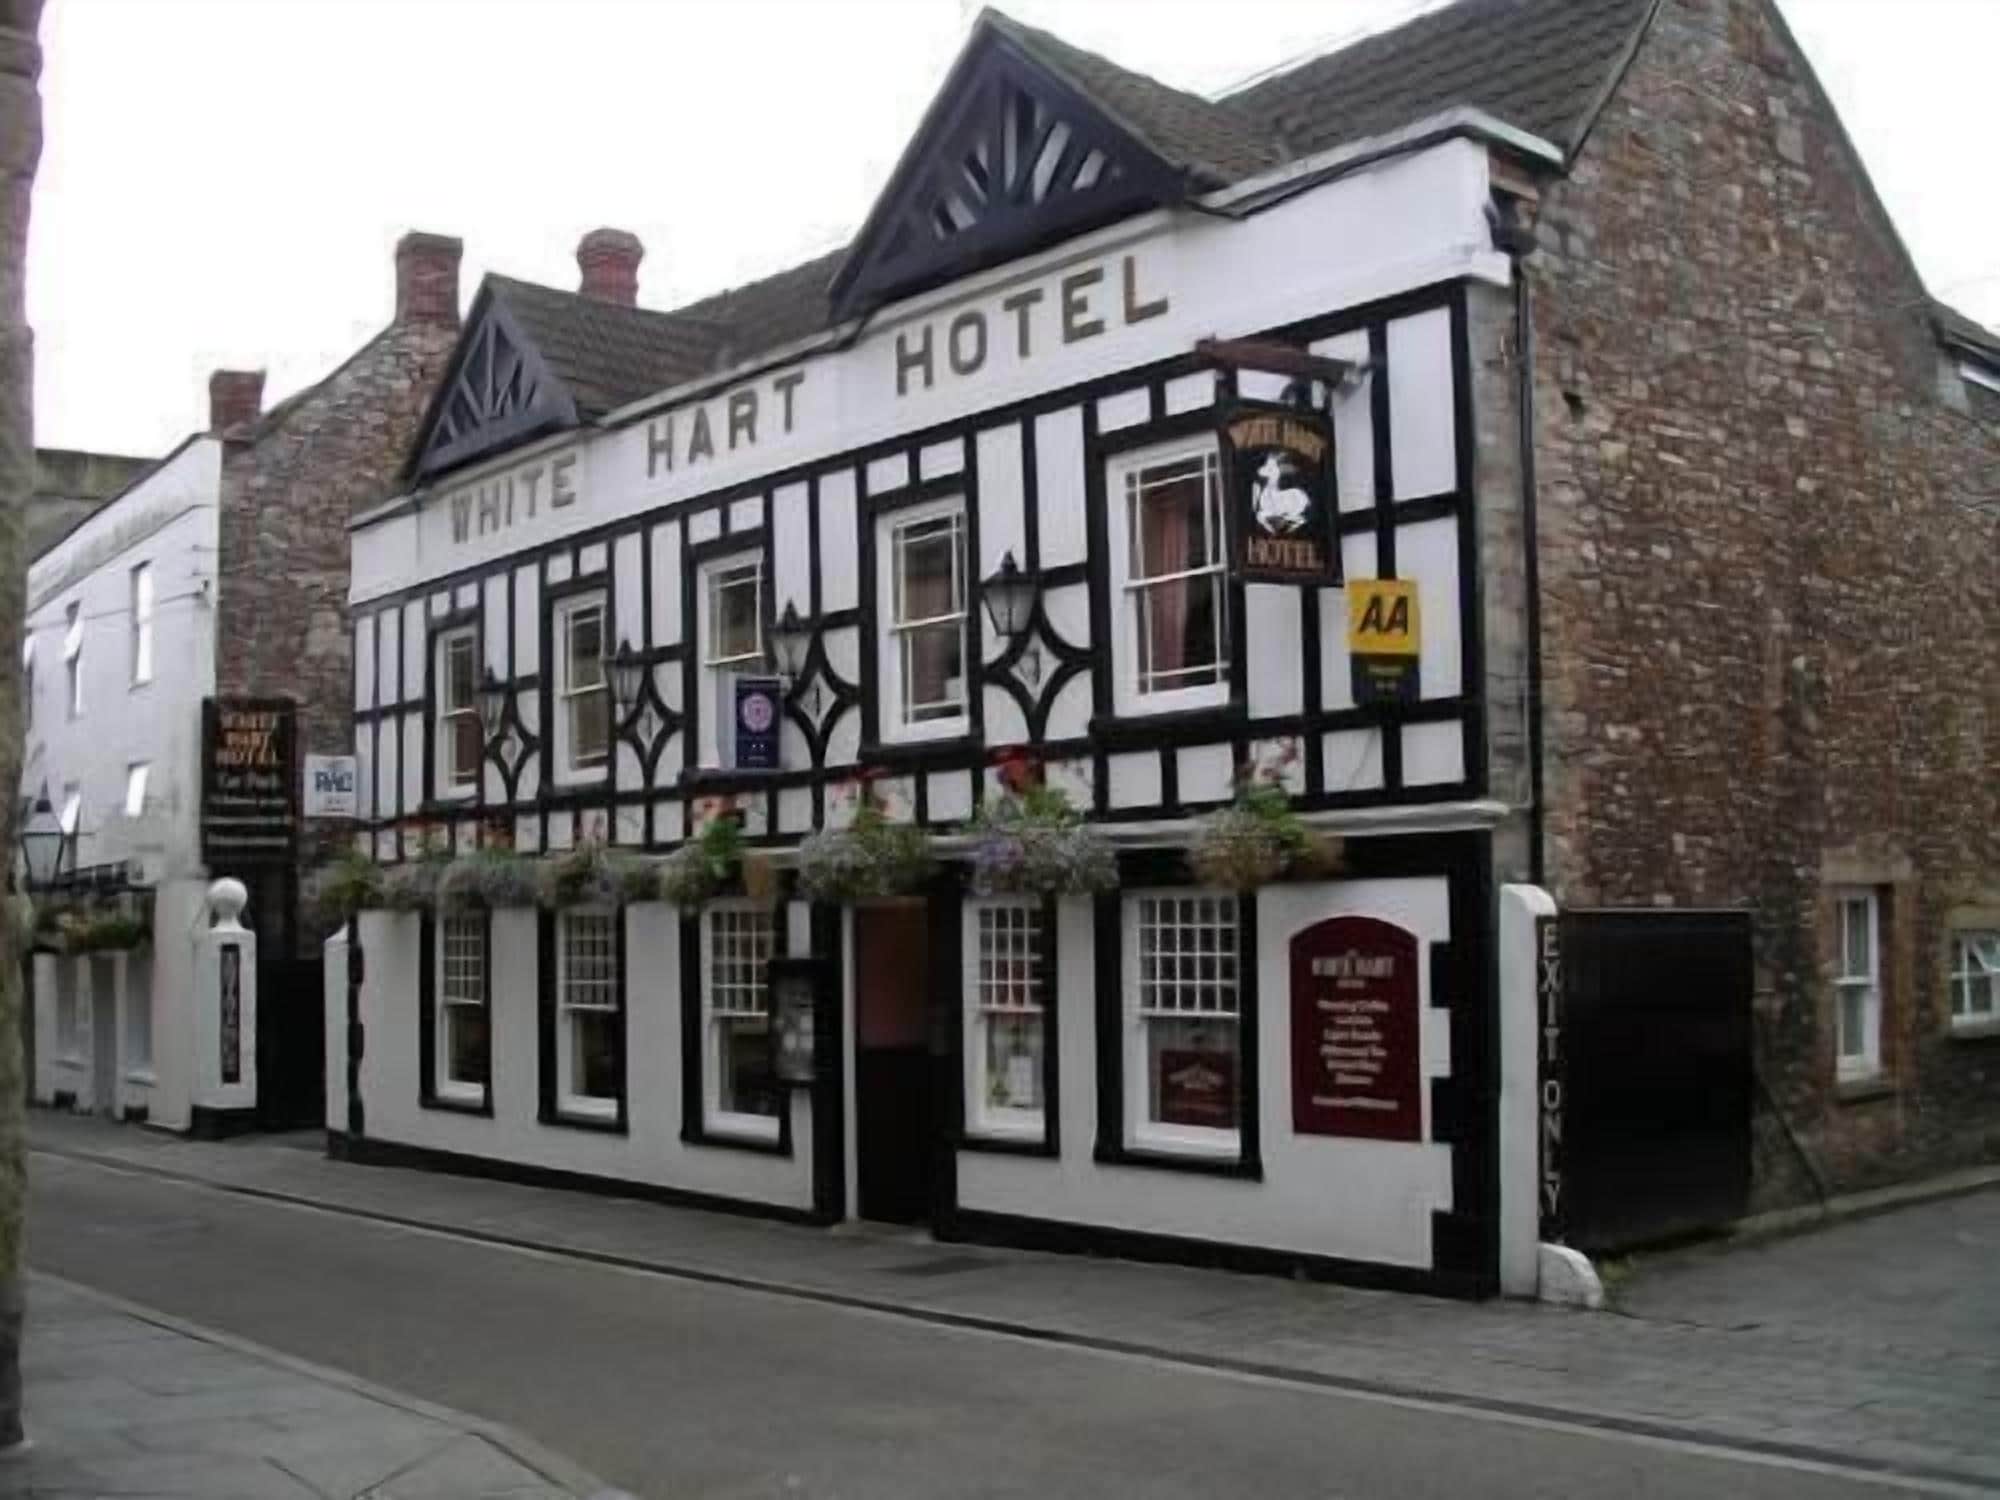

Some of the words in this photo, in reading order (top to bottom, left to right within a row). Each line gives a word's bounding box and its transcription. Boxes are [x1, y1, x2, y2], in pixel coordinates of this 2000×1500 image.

[451, 453, 577, 544] WHITE
[647, 369, 805, 480] HART
[896, 255, 1168, 396] HOTEL
[1247, 536, 1325, 569] HOTEL
[1358, 595, 1409, 636] AA
[1542, 922, 1560, 1061] EXIT
[1543, 1079, 1561, 1217] ONLY
